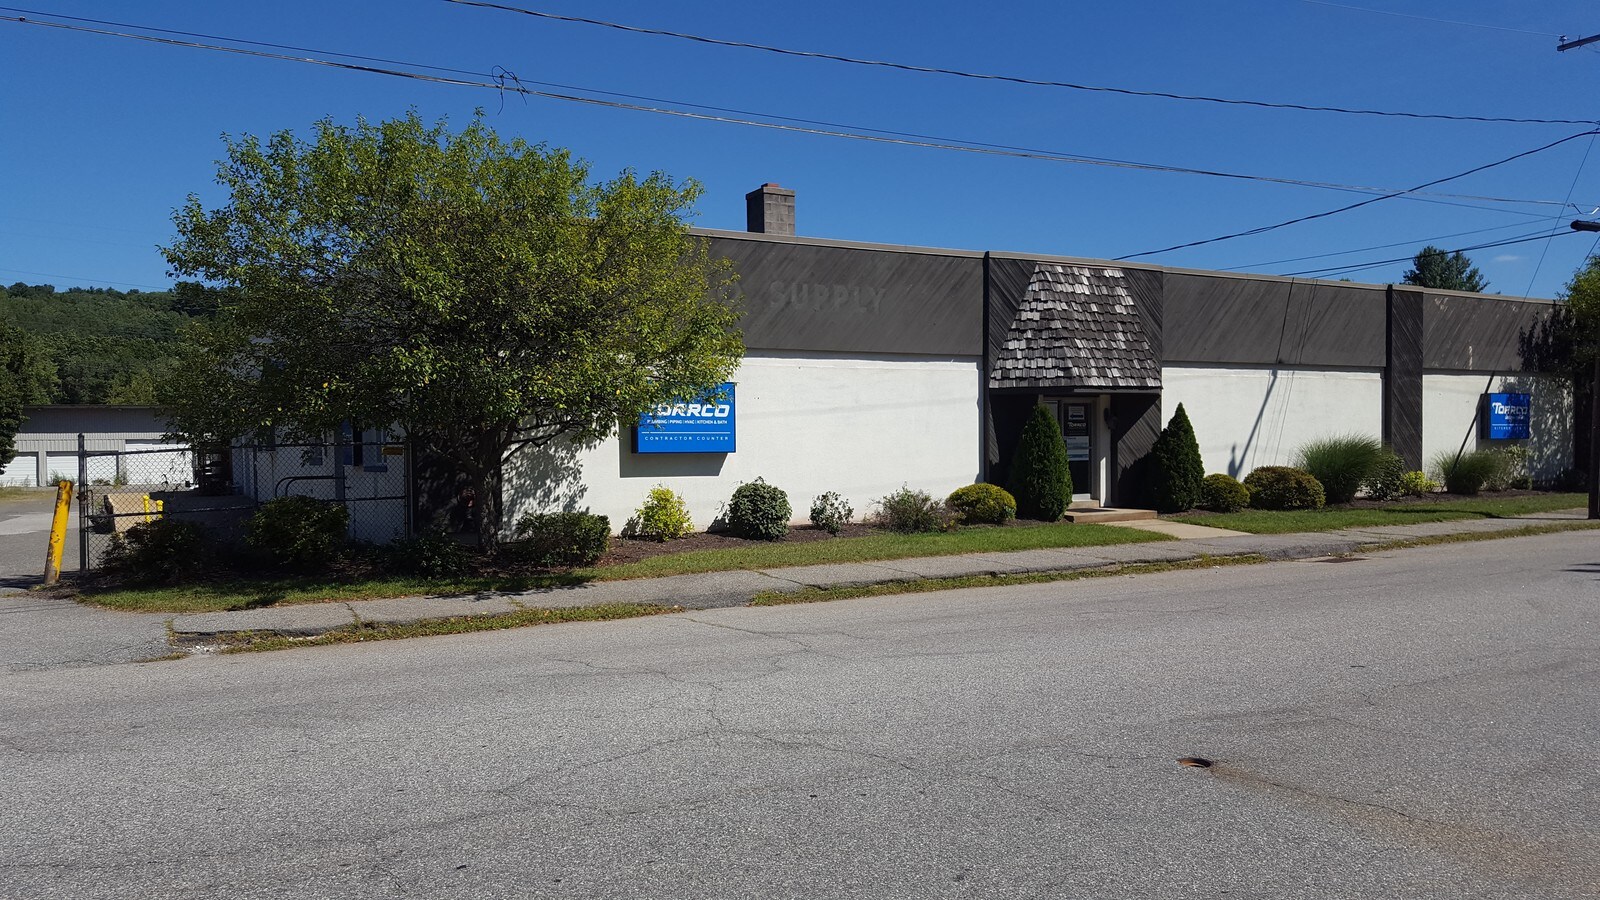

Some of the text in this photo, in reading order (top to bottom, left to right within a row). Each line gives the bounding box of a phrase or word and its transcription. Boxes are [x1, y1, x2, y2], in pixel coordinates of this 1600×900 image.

[768, 279, 887, 314] SUPPLY
[647, 403, 730, 418] ORRCO
[1492, 402, 1528, 415] TORRCO
